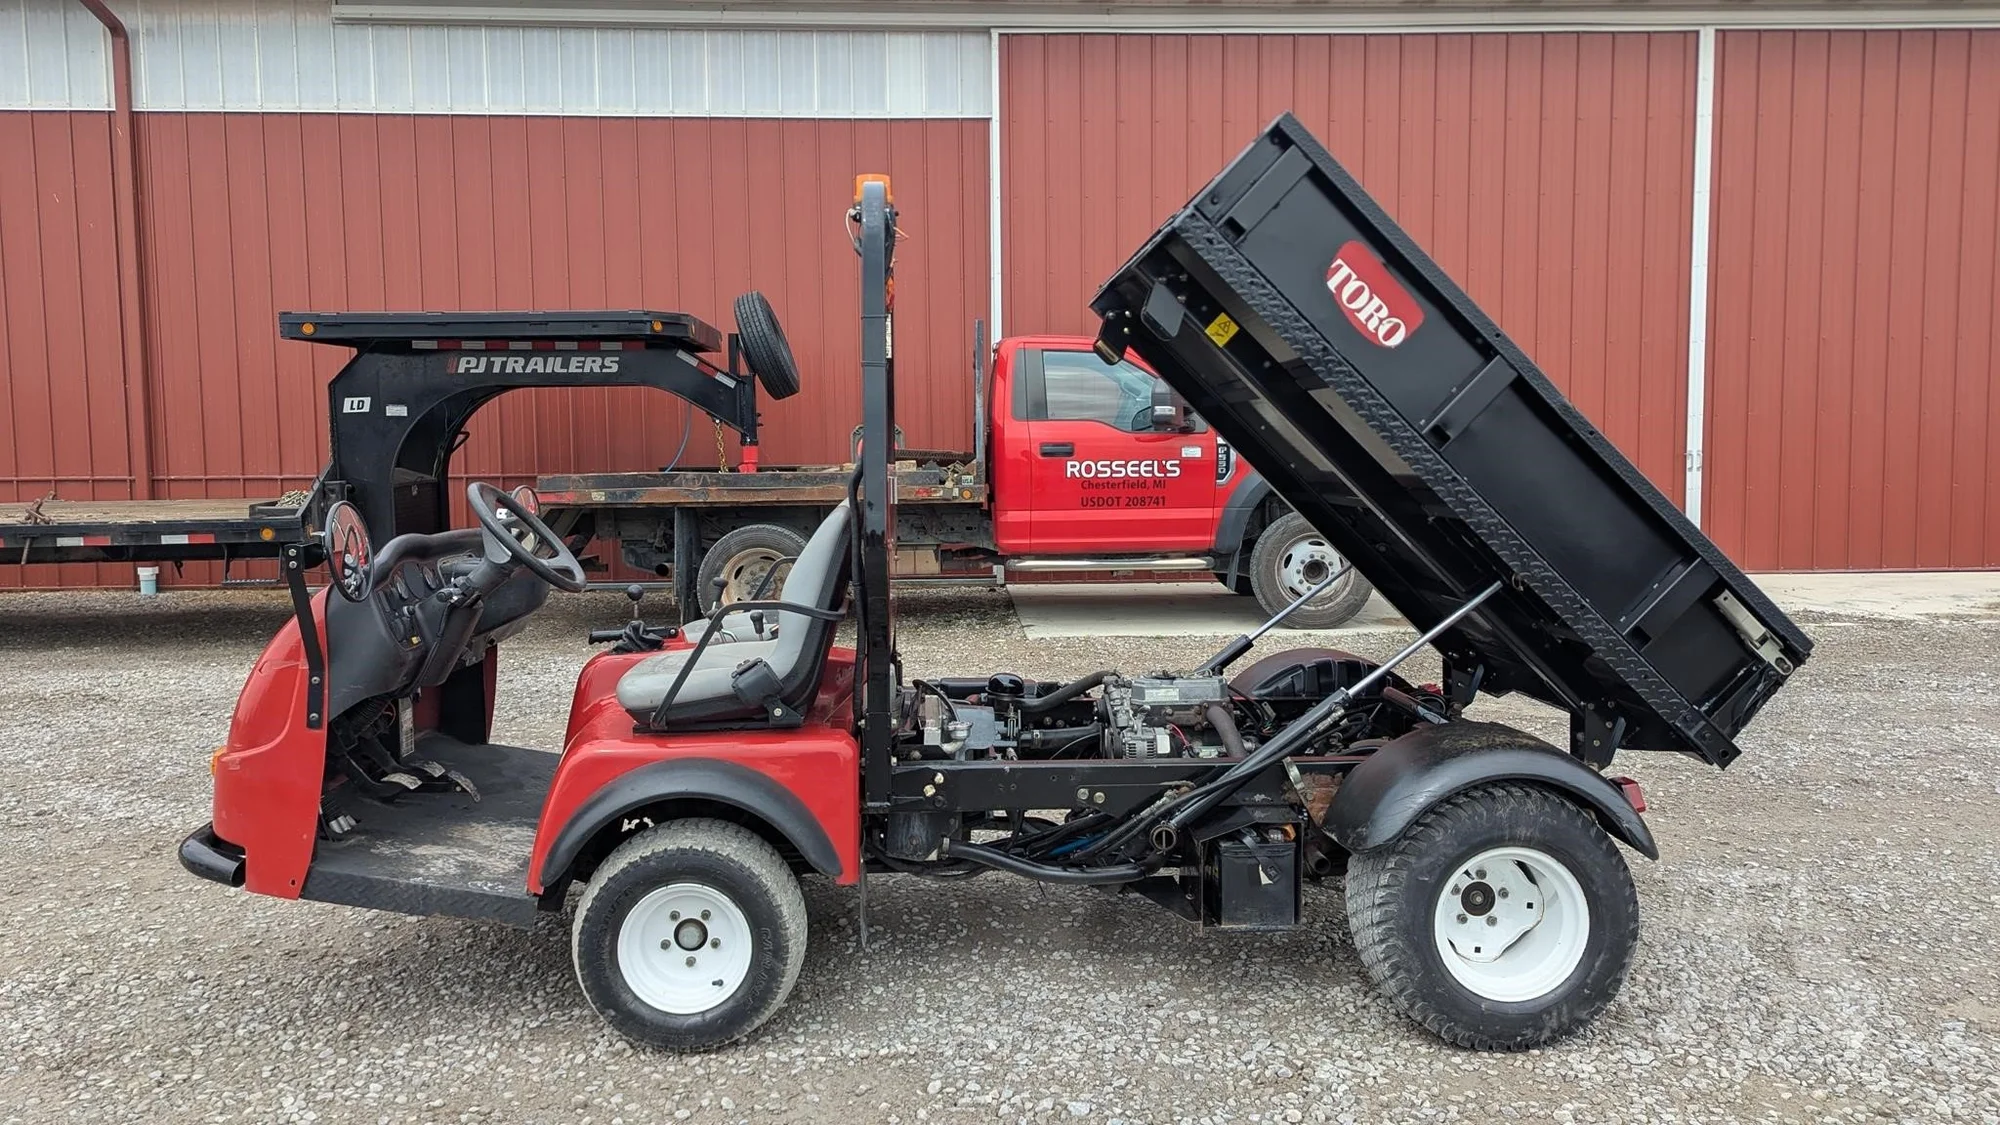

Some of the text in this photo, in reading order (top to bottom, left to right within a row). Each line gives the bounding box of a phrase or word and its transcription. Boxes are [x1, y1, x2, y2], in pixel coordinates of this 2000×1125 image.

[1327, 258, 1406, 346] TORO
[457, 356, 619, 374] PJ TRAILERS
[349, 399, 365, 411] LD
[1066, 459, 1181, 478] ROSSEEL'S
[1080, 479, 1166, 491] Chesterfield, MI
[1080, 495, 1166, 508] USDOT 208741
